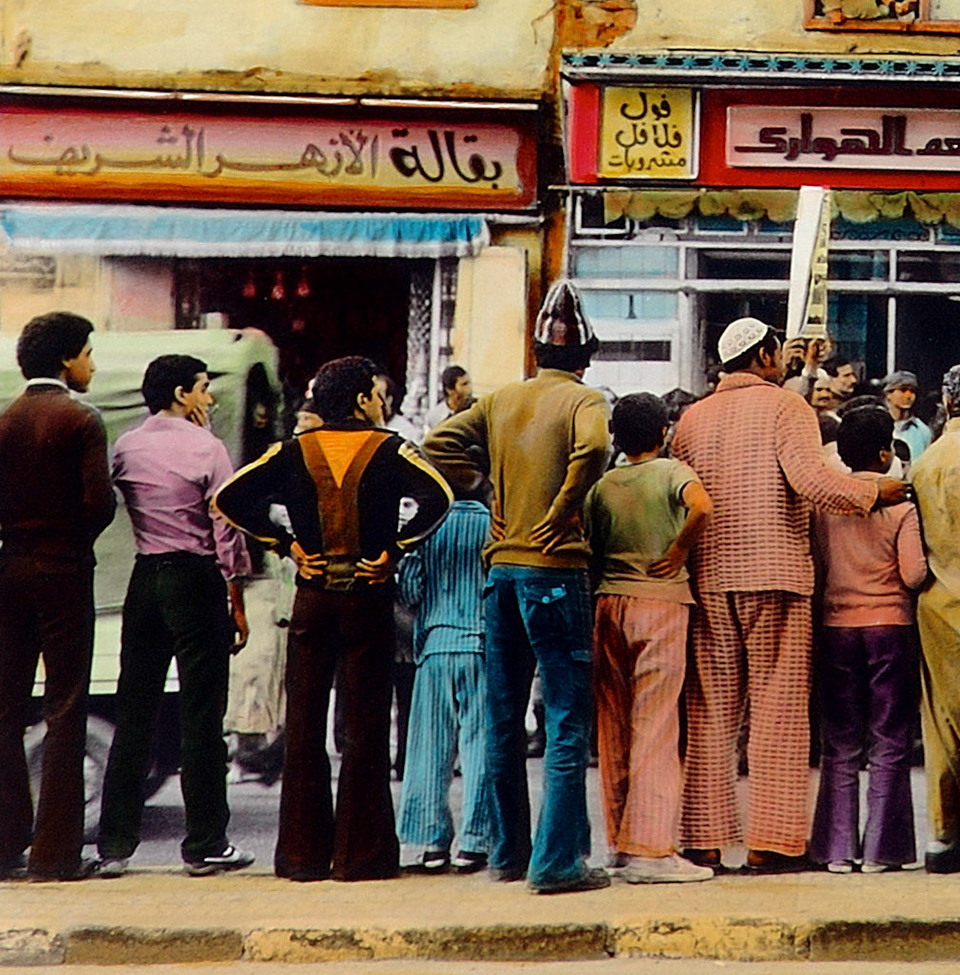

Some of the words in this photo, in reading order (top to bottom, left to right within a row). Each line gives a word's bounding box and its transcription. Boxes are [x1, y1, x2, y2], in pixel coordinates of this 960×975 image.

[620, 91, 671, 121] فول
[7, 124, 206, 176] الشريف
[615, 122, 682, 148] فلافل
[389, 128, 503, 189] بقالة
[608, 150, 687, 172] مشروبات
